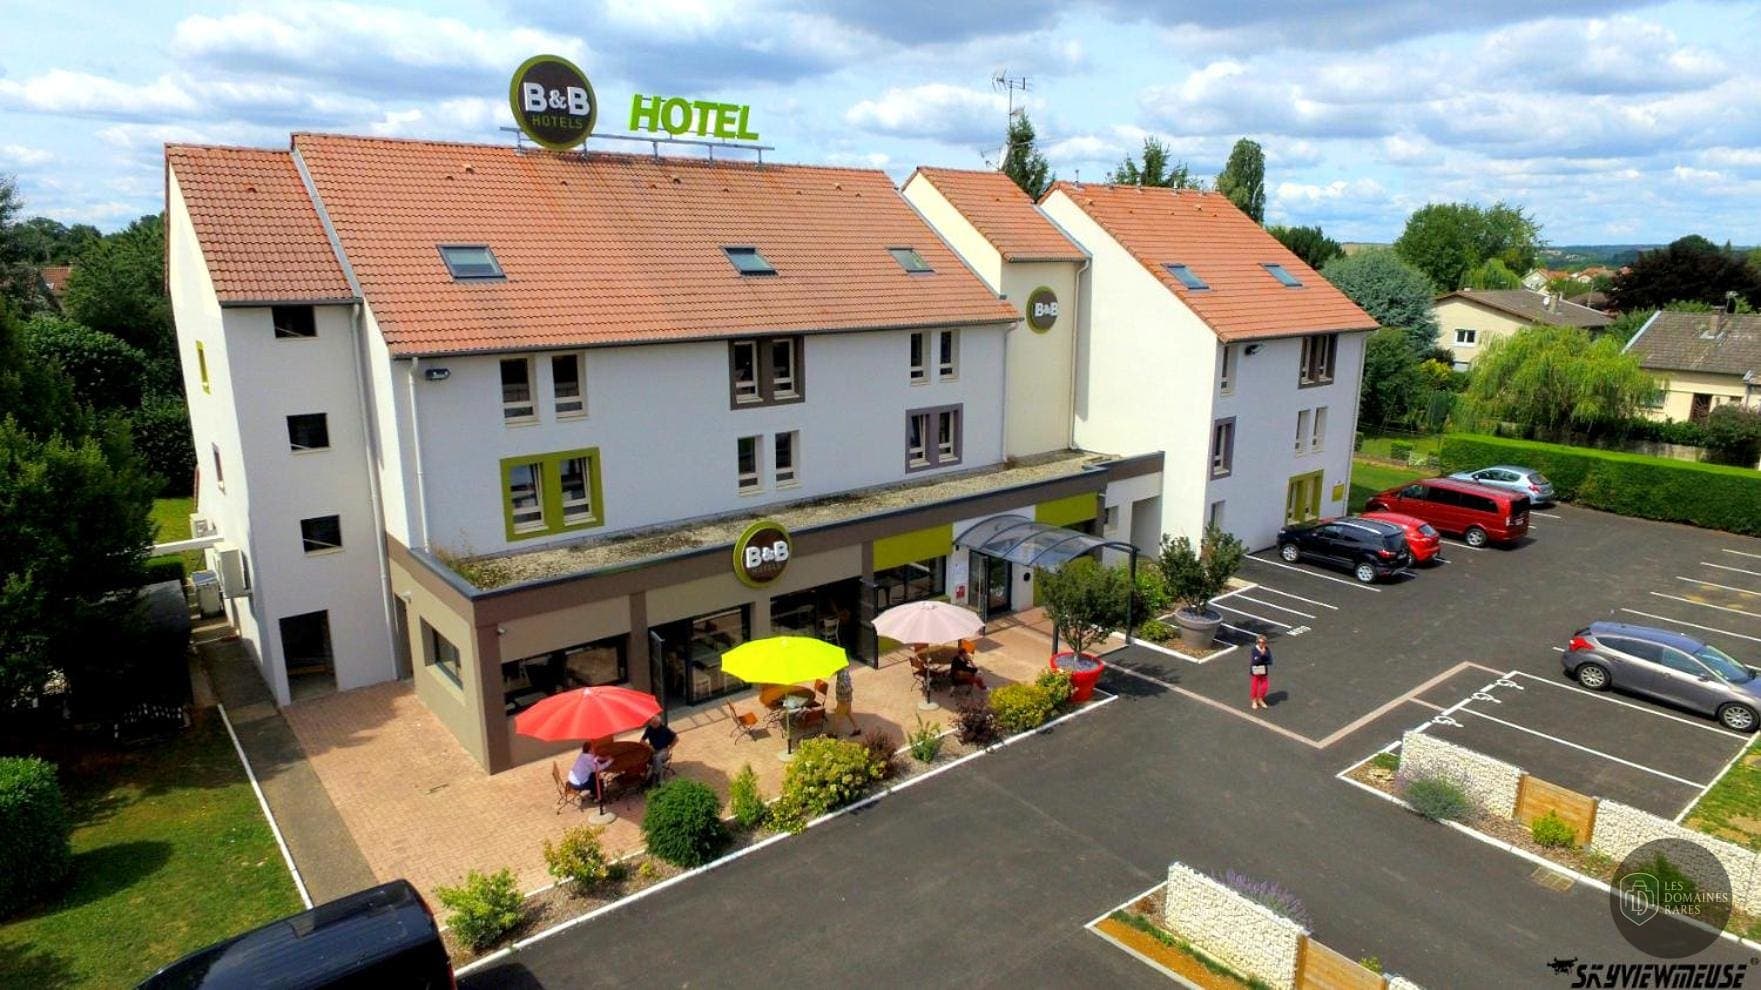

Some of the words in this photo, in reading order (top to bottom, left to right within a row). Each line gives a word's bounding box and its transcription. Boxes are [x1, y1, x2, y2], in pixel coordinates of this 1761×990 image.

[523, 82, 590, 116] B&B
[532, 115, 583, 129] HOTELS
[629, 94, 759, 140] HOTEL
[745, 540, 789, 568] B&B
